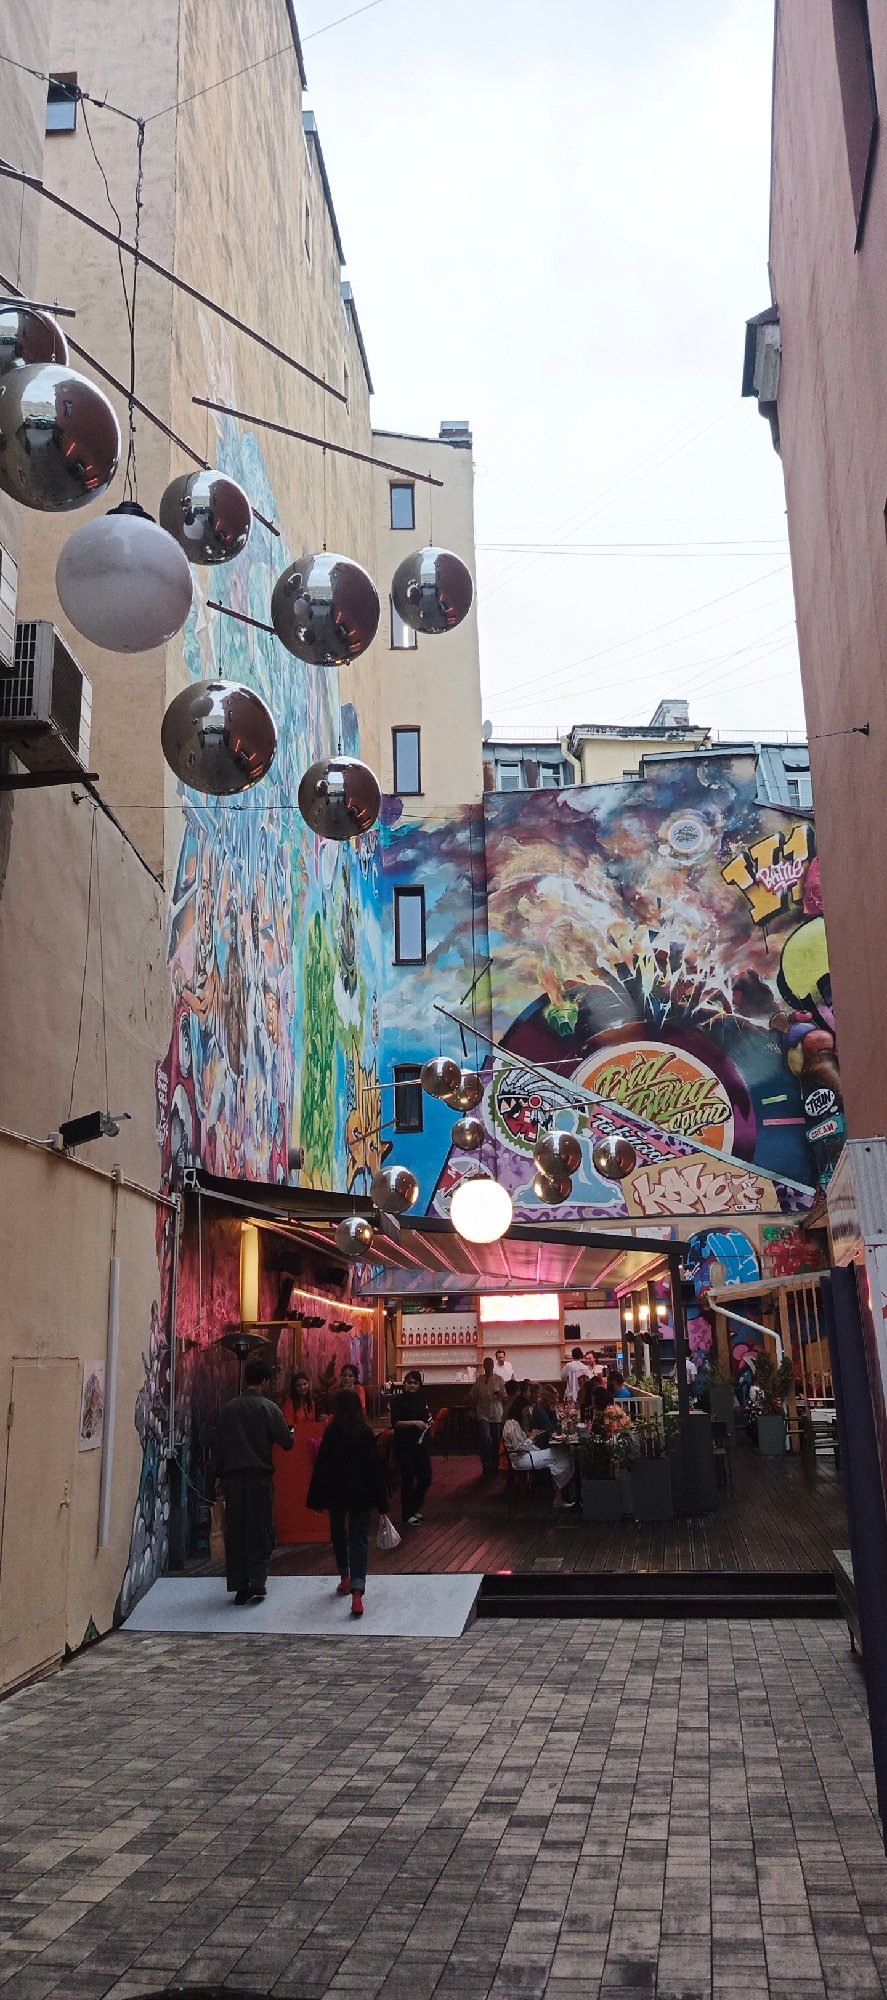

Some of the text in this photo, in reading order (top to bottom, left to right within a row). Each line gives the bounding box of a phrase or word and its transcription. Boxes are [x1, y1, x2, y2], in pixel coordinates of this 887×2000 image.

[594, 1051, 681, 1102] Big
[627, 1078, 728, 1125] Bang
[811, 1123, 834, 1139] CREAM
